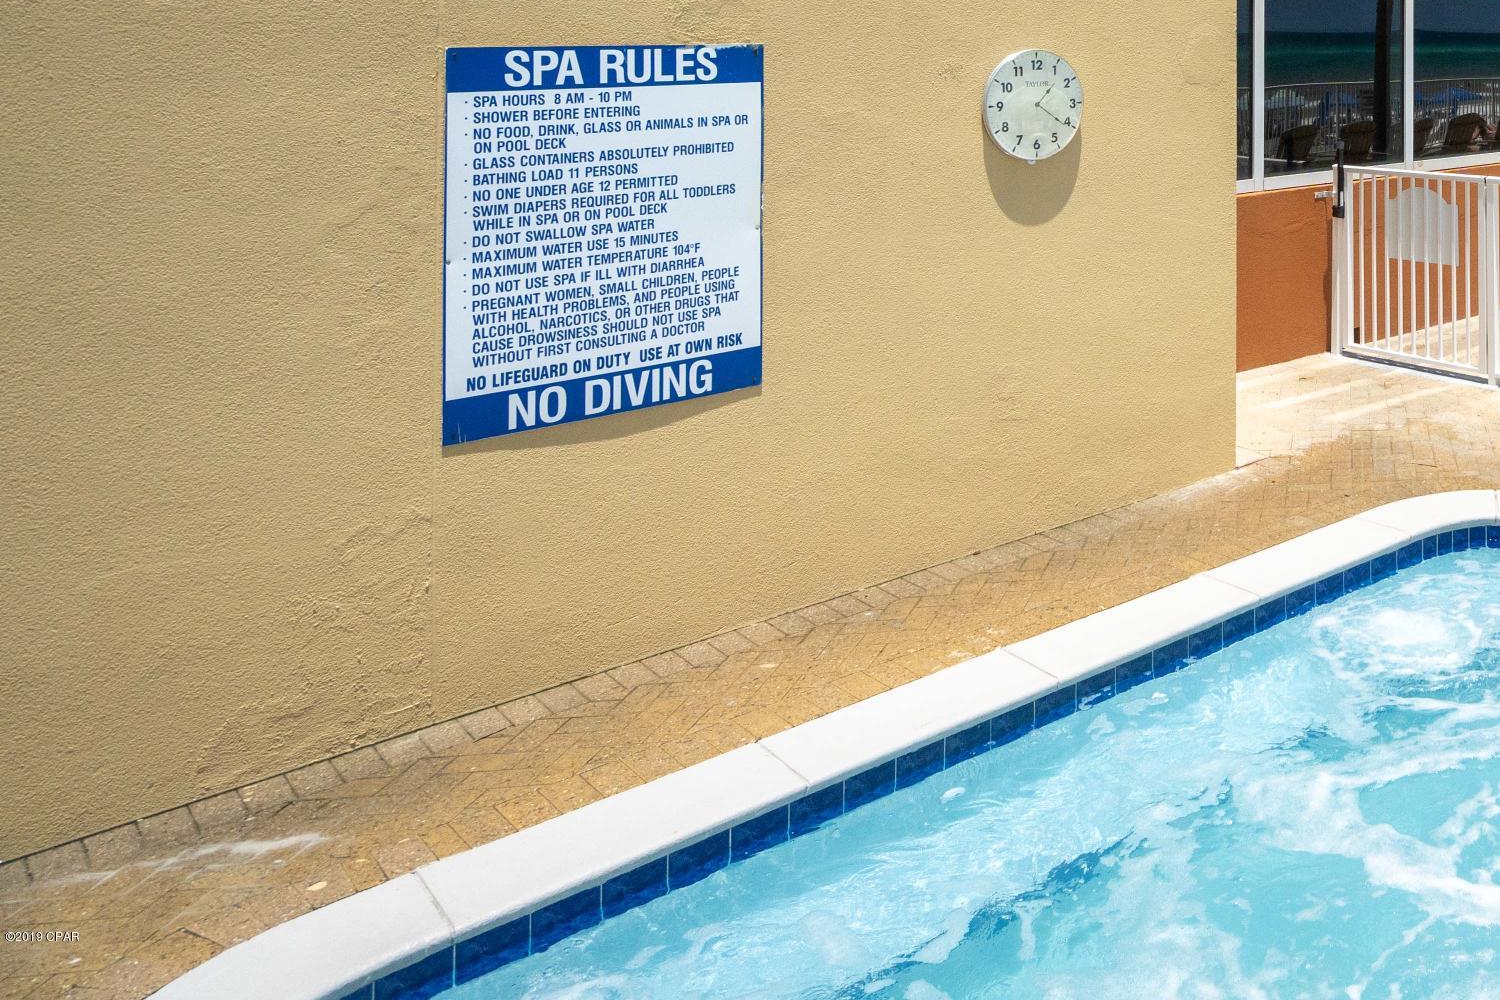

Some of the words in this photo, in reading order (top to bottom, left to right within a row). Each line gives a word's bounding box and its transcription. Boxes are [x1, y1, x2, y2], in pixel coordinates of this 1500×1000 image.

[505, 50, 583, 86] SPA
[600, 47, 718, 83] RULES
[1014, 67, 1023, 76] 11
[1031, 60, 1042, 70] 12
[1052, 66, 1057, 75] 1
[1001, 83, 1012, 93] 10
[1064, 79, 1070, 88] 2
[474, 96, 497, 108] SPA
[503, 94, 545, 106] HOURS
[554, 94, 561, 104] 8
[566, 93, 584, 104] AM
[598, 92, 610, 102] 10
[615, 91, 632, 102] PM
[996, 102, 1003, 111] 9
[1070, 99, 1076, 108] 3
[473, 110, 528, 124] SHOWER
[534, 108, 579, 121] BEFORE
[584, 106, 640, 118] ENTERING
[474, 128, 491, 140] NO
[497, 126, 533, 138] FOOD,
[539, 124, 578, 136] DRINK,
[584, 121, 621, 134] GLASS
[626, 120, 641, 131] OR
[646, 118, 693, 130] ANIMALS
[698, 117, 707, 127] IN
[712, 116, 730, 126] SPA
[735, 115, 748, 125] OR
[1002, 122, 1009, 132] 8
[1064, 117, 1070, 126] 4
[474, 142, 491, 154] ON
[497, 140, 530, 152] POOL
[536, 138, 566, 150] DECK
[1017, 135, 1023, 145] 7
[1034, 140, 1040, 149] 6
[1052, 133, 1057, 143] 5
[473, 156, 515, 170] GLASS
[520, 151, 594, 167] CONTAINERS
[599, 146, 668, 161] ABSOLUTELY
[674, 142, 734, 156] PROHIBITED
[473, 171, 526, 186] BATHING
[532, 169, 563, 182] LOAD
[568, 168, 579, 178] 11
[586, 163, 638, 177] PERSONS
[473, 190, 490, 202] NO
[496, 188, 520, 200] ONE
[526, 184, 566, 198] UNDER
[571, 182, 594, 194] AGE
[599, 180, 610, 191] 12
[616, 175, 678, 190] PERMITTED
[473, 204, 508, 218] SWIM
[514, 199, 566, 214] DIAPERS
[572, 194, 629, 208] REQUIRED
[634, 191, 655, 203] FOR
[659, 189, 679, 200] ALL
[683, 184, 735, 198] TODDLERS
[473, 217, 513, 231] WHILE
[519, 215, 530, 227] IN
[536, 213, 558, 225] SPA
[564, 211, 579, 223] OR
[585, 209, 600, 221] ON
[606, 206, 635, 219] POOL
[640, 203, 667, 215] DECK
[472, 235, 490, 247] DO
[496, 232, 521, 245] NOT
[526, 226, 586, 242] SWALLOW
[592, 223, 613, 235] SPA
[618, 219, 654, 232] WATER
[472, 246, 536, 263] MAXIMUM
[542, 242, 582, 256] WATER
[588, 238, 609, 251] USE
[614, 237, 625, 248] 15
[630, 231, 678, 246] MINUTES
[472, 262, 536, 280] MAXIMUM
[542, 257, 582, 271] WATER
[587, 247, 668, 266] TEMPERATURE
[472, 283, 490, 296] DO
[496, 279, 520, 293] NOT
[526, 276, 548, 289] USE
[554, 273, 576, 286] SPA
[581, 271, 590, 282] IF
[596, 269, 612, 280] ILL
[616, 264, 646, 278] WITH
[651, 257, 704, 273] DIARRHEA
[472, 293, 540, 312] PREGNANT
[545, 286, 594, 302] WOMEN,
[599, 281, 637, 295] SMALL
[642, 272, 697, 289] CHILDREN,
[702, 266, 739, 281] PEOPLE
[473, 311, 506, 326] WITH
[512, 304, 558, 320] HEALTH
[564, 294, 629, 313] PROBLEMS,
[634, 291, 656, 303] AND
[661, 284, 700, 299] PEOPLE
[705, 279, 734, 293] USING
[472, 322, 534, 340] ALCOHOL,
[540, 310, 610, 330] NARCOTICS,
[615, 307, 630, 319] OR
[635, 301, 670, 316] OTHER
[675, 295, 710, 310] DRUGS
[714, 291, 739, 304] THAT
[473, 337, 513, 354] CAUSE
[519, 325, 599, 349] DROWSINESS
[603, 318, 648, 334] SHOULD
[653, 313, 674, 326] NOT
[678, 310, 698, 322] USE
[702, 306, 721, 318] SPA
[472, 350, 531, 368] WITHOUT
[537, 344, 570, 358] FIRST
[576, 330, 646, 352] CONSULTING
[651, 329, 657, 339] A
[662, 321, 704, 337] DOCTOR
[467, 376, 486, 392] NO
[492, 363, 568, 388] LIFEGUARD
[573, 358, 591, 374] ON
[597, 352, 630, 370] DUTY
[640, 346, 662, 362] USE
[667, 343, 680, 358] AT
[685, 338, 712, 354] OWN
[717, 332, 742, 349] RISK
[509, 386, 566, 430] NO
[586, 360, 712, 416] DIVING
